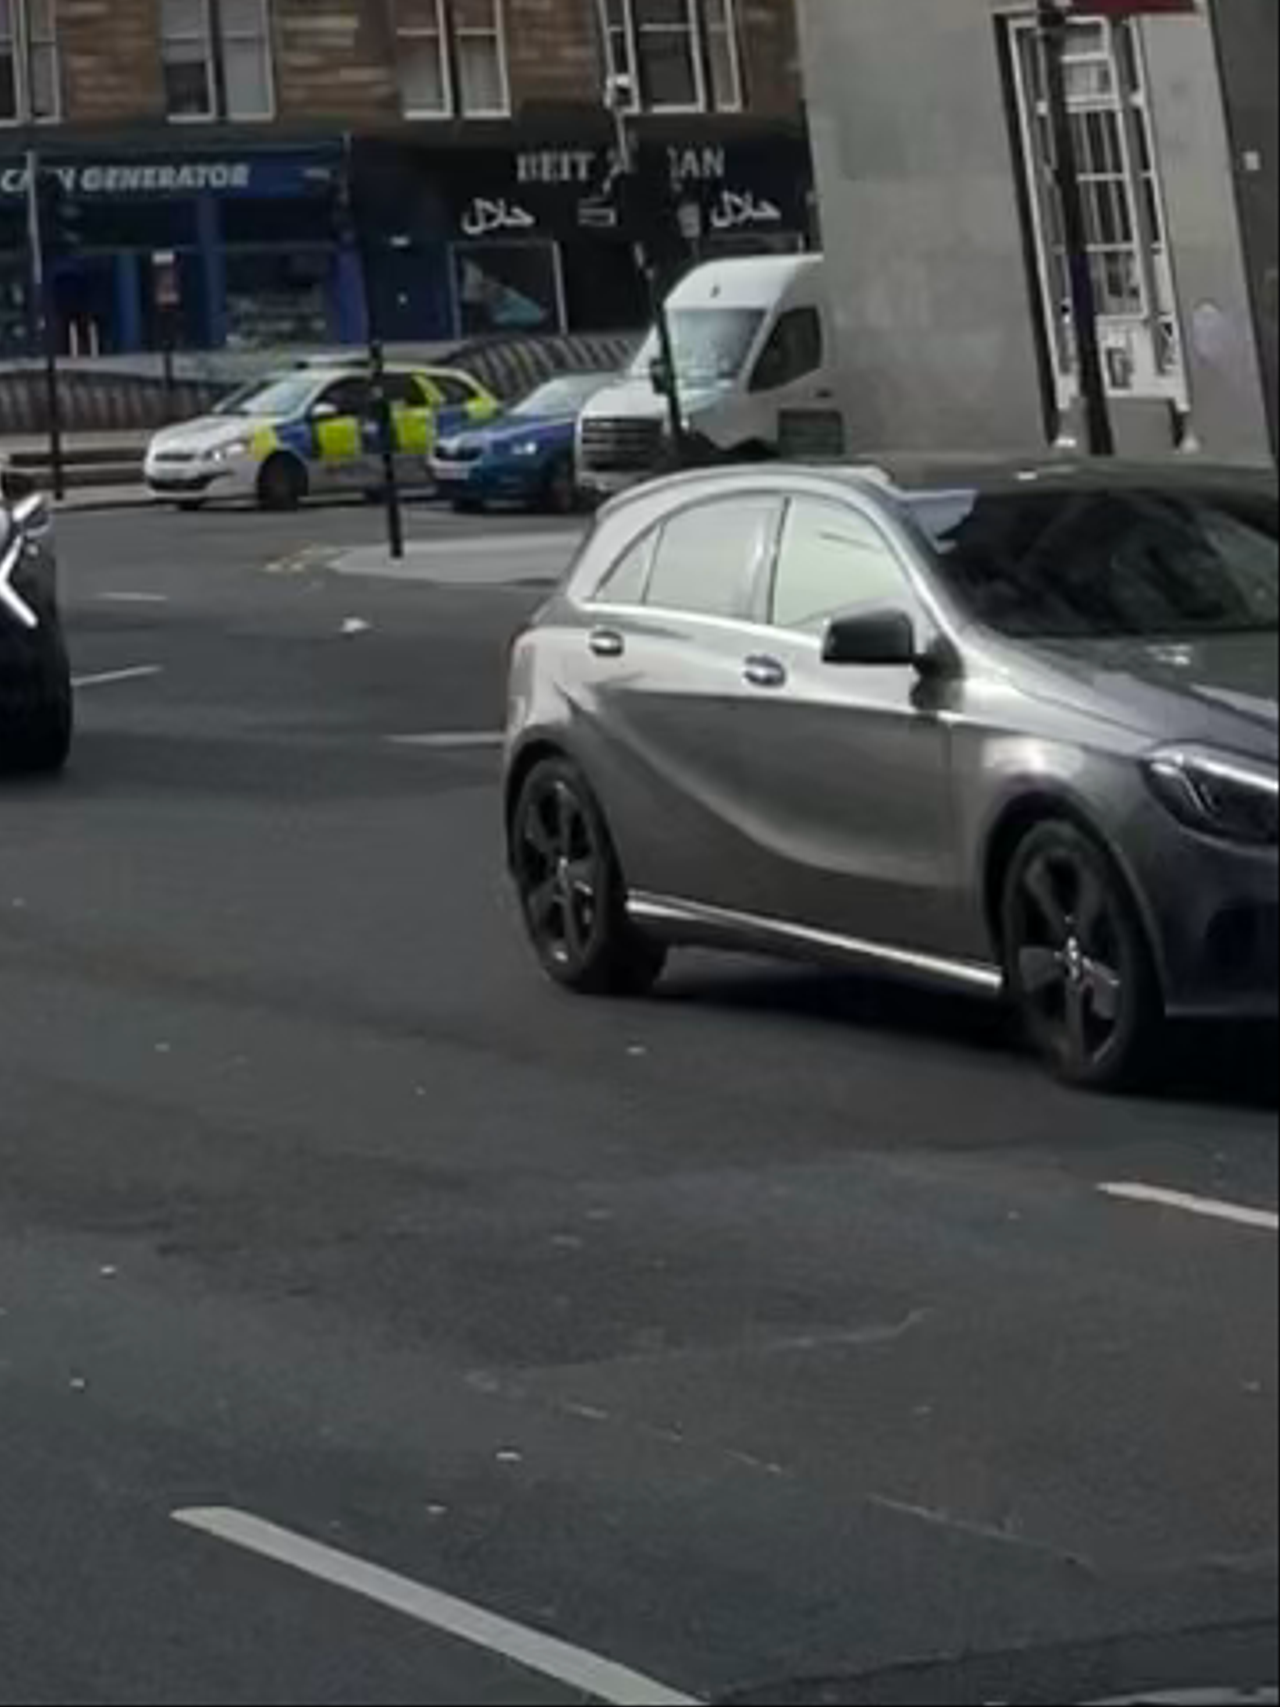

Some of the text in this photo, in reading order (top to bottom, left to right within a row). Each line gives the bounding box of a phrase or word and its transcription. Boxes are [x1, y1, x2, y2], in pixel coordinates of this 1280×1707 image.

[80, 163, 251, 192] GENERATOR
[461, 197, 536, 235] حلال
[710, 189, 782, 228] حلال
